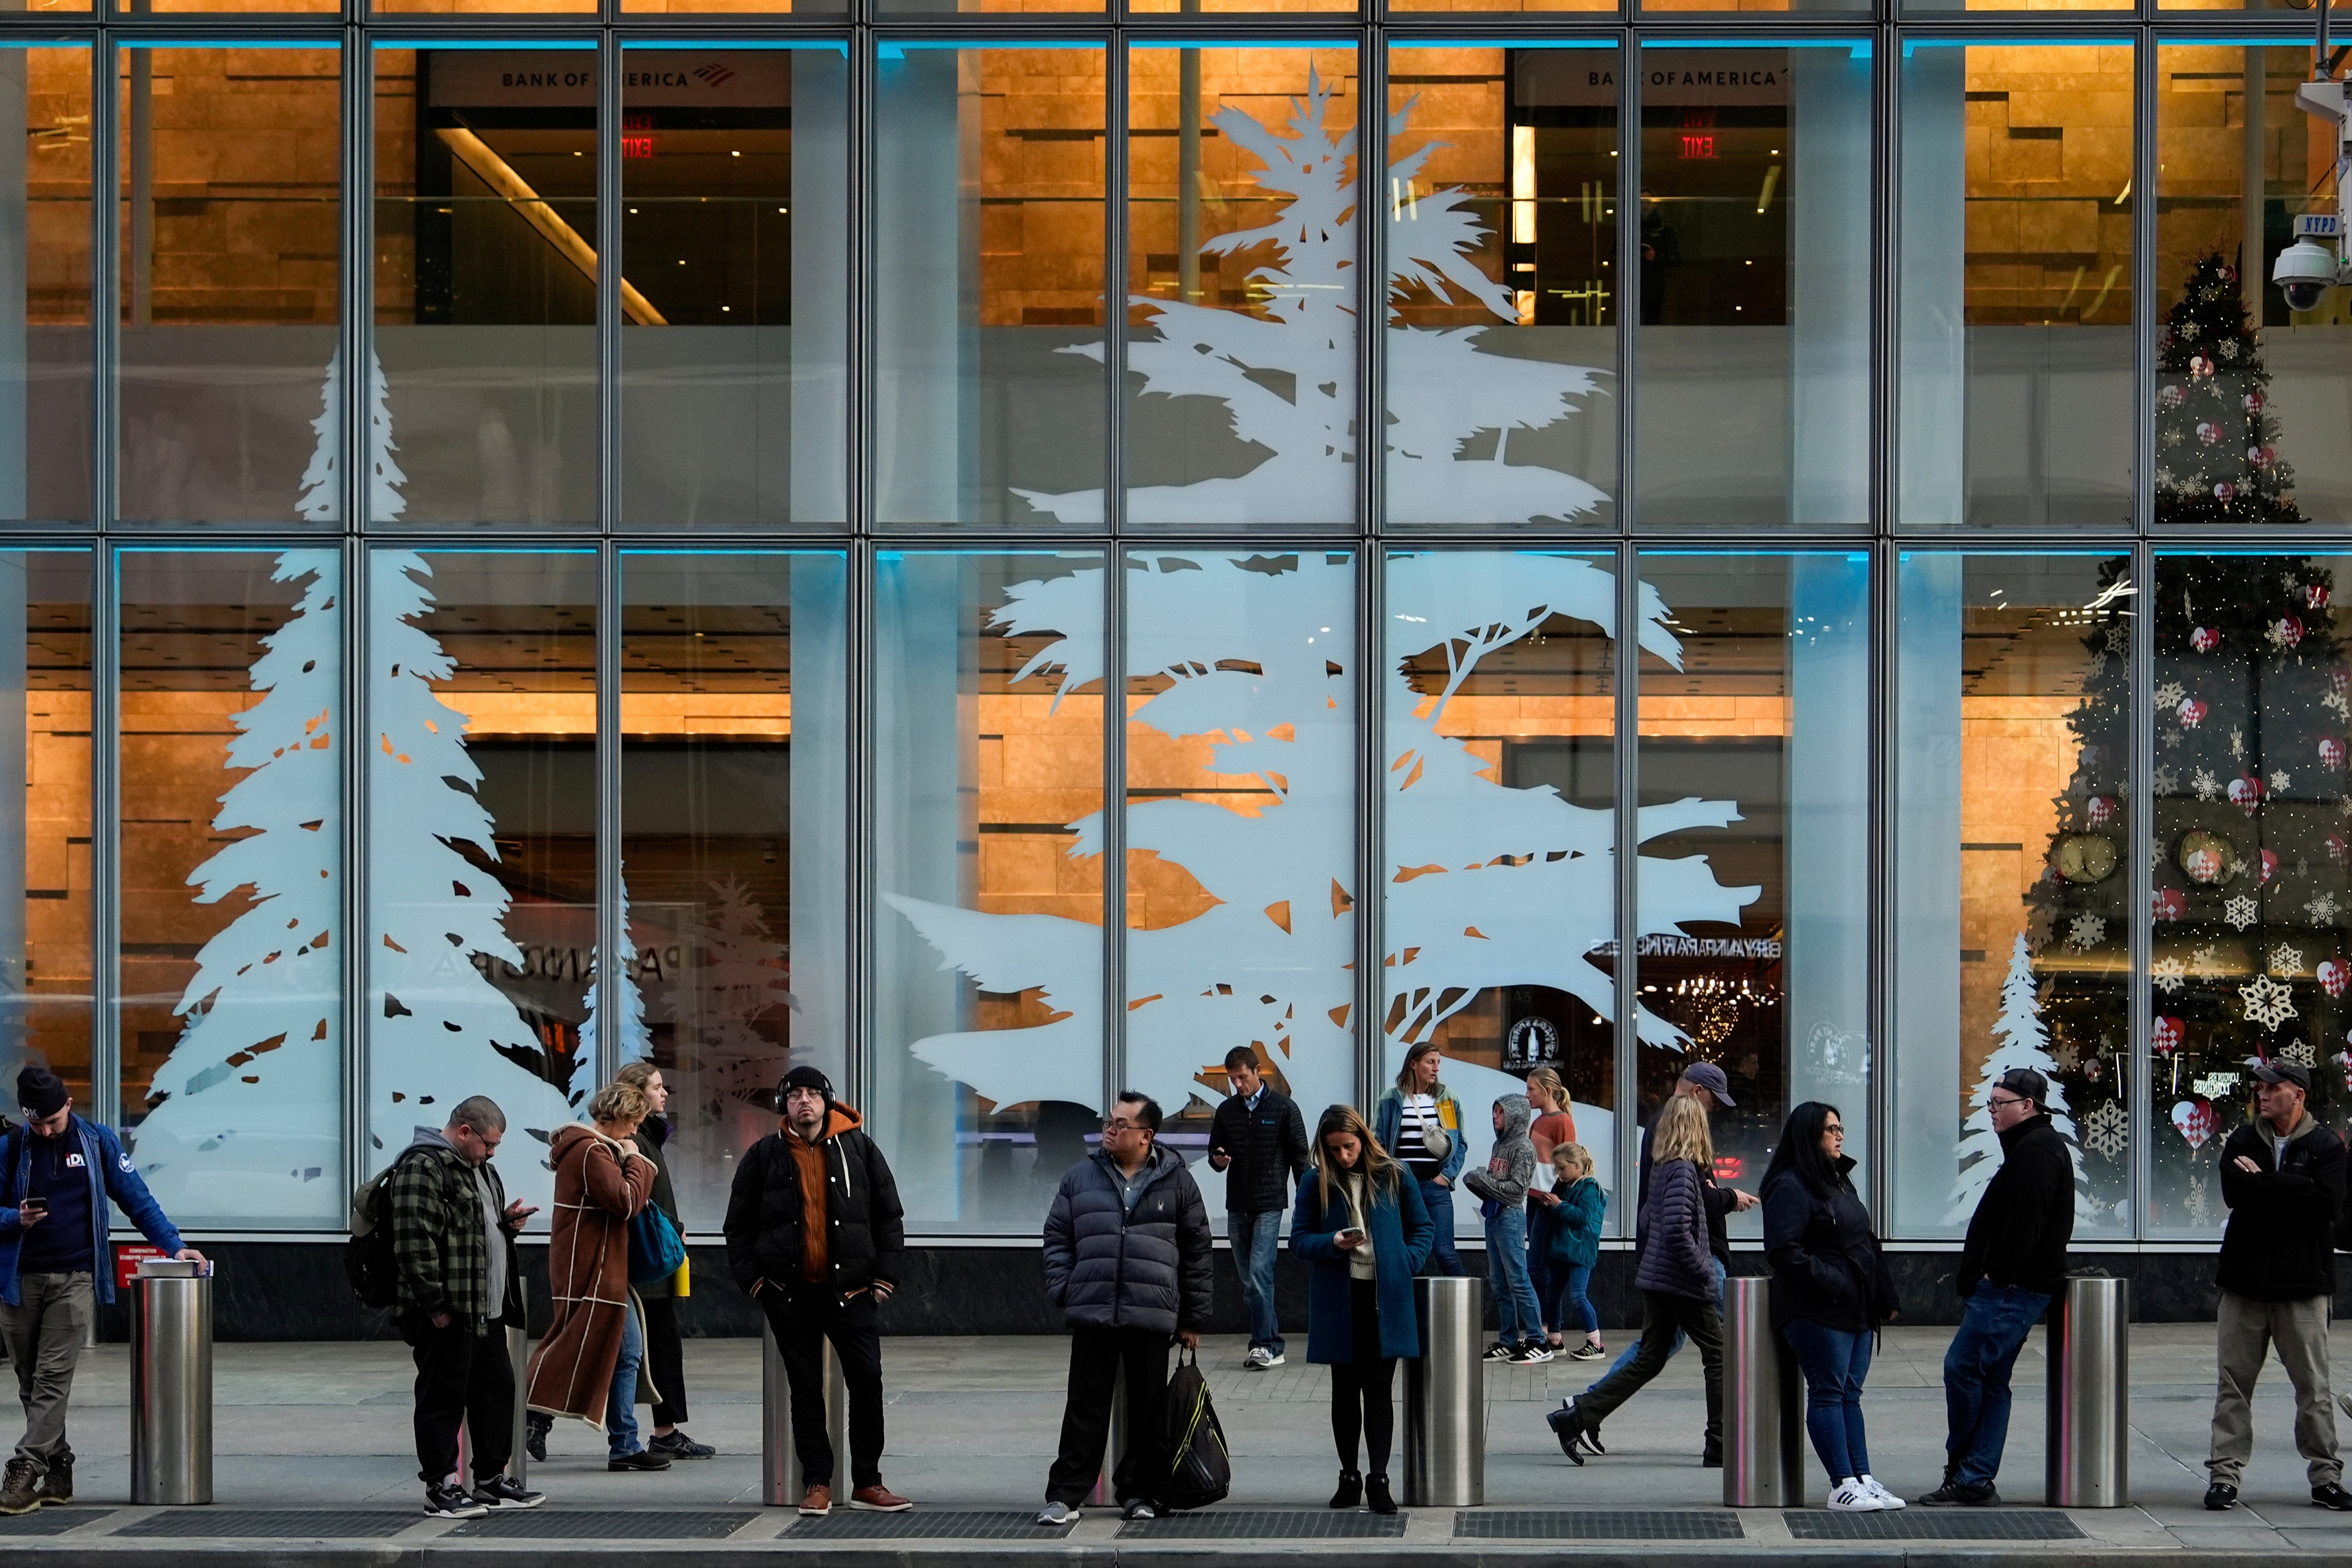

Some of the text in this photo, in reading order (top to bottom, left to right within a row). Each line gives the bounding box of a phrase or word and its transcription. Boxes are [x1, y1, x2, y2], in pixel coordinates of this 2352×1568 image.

[502, 73, 688, 86] BANK OF ERICA
[1651, 71, 1676, 85] OF
[1682, 71, 1776, 85] AMERICA
[2305, 217, 2336, 232] NYPD
